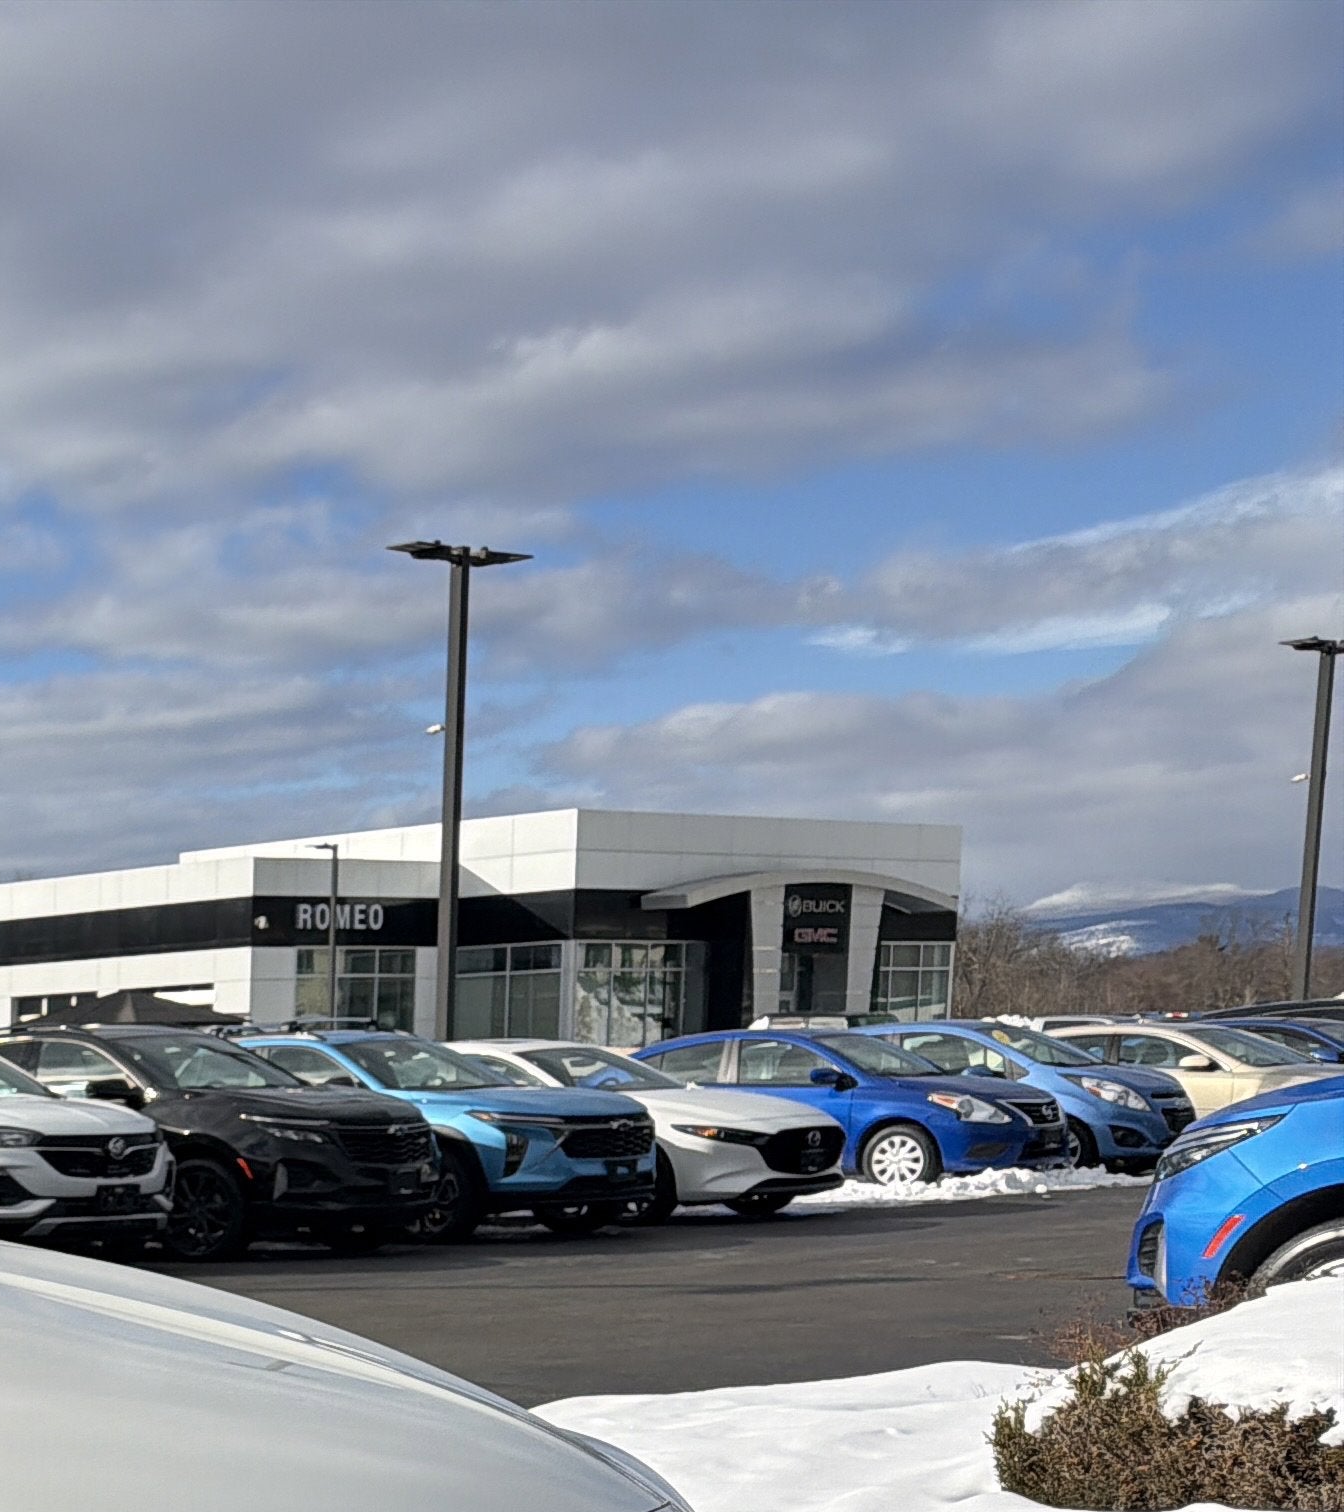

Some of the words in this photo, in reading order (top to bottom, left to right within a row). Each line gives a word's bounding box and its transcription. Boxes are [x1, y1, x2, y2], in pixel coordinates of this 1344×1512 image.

[802, 899, 845, 913] BUICK
[295, 903, 384, 930] ROMEO
[794, 928, 838, 943] GMC
